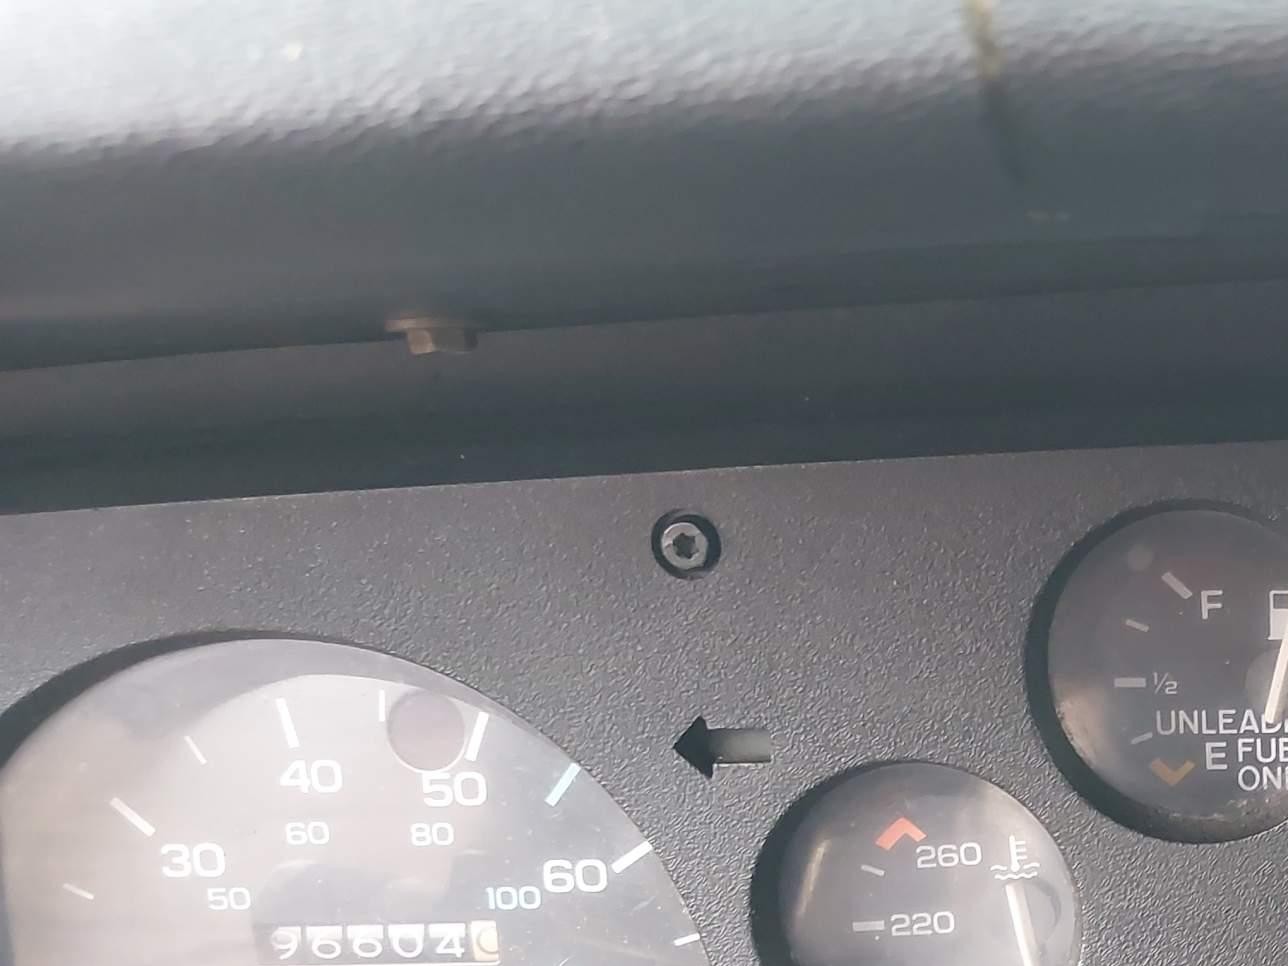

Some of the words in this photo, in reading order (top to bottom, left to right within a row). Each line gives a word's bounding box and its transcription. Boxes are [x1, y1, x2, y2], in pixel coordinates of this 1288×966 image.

[1201, 590, 1223, 619] F
[1205, 742, 1227, 770] E
[279, 759, 343, 793] 40
[422, 773, 487, 806] 50
[286, 822, 329, 845] 60
[410, 823, 454, 846] 80
[161, 843, 225, 878] 30
[916, 842, 982, 868] 260
[542, 859, 608, 894] 60
[207, 888, 251, 910] 50
[486, 886, 541, 910] 100
[891, 911, 955, 936] 220
